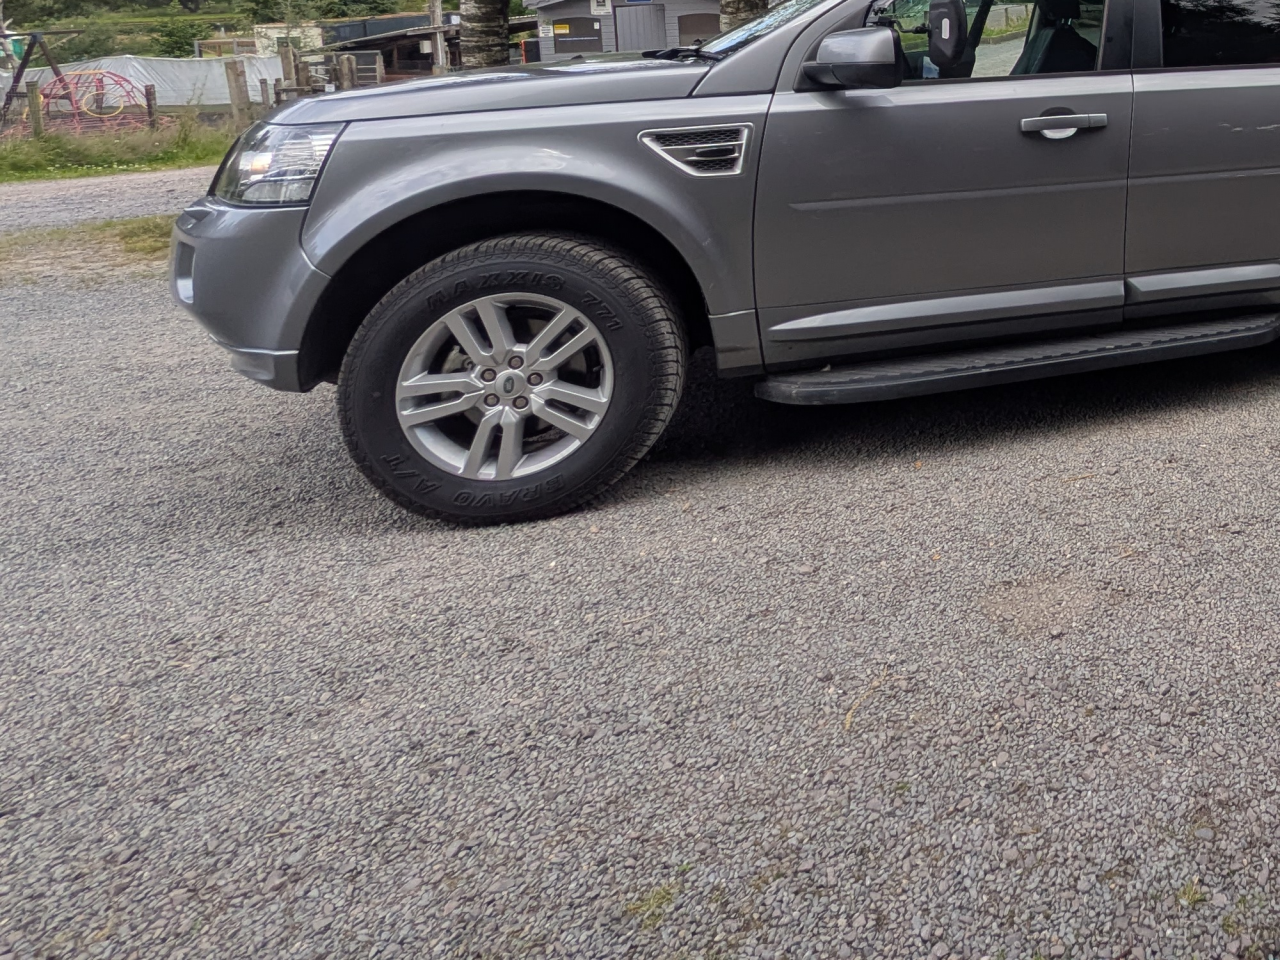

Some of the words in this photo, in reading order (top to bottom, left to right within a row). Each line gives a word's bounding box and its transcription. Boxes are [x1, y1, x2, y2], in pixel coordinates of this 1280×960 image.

[425, 269, 567, 311] MAXXIS
[581, 291, 625, 333] 771
[380, 454, 443, 499] A/T
[452, 472, 565, 507] BRAVO
